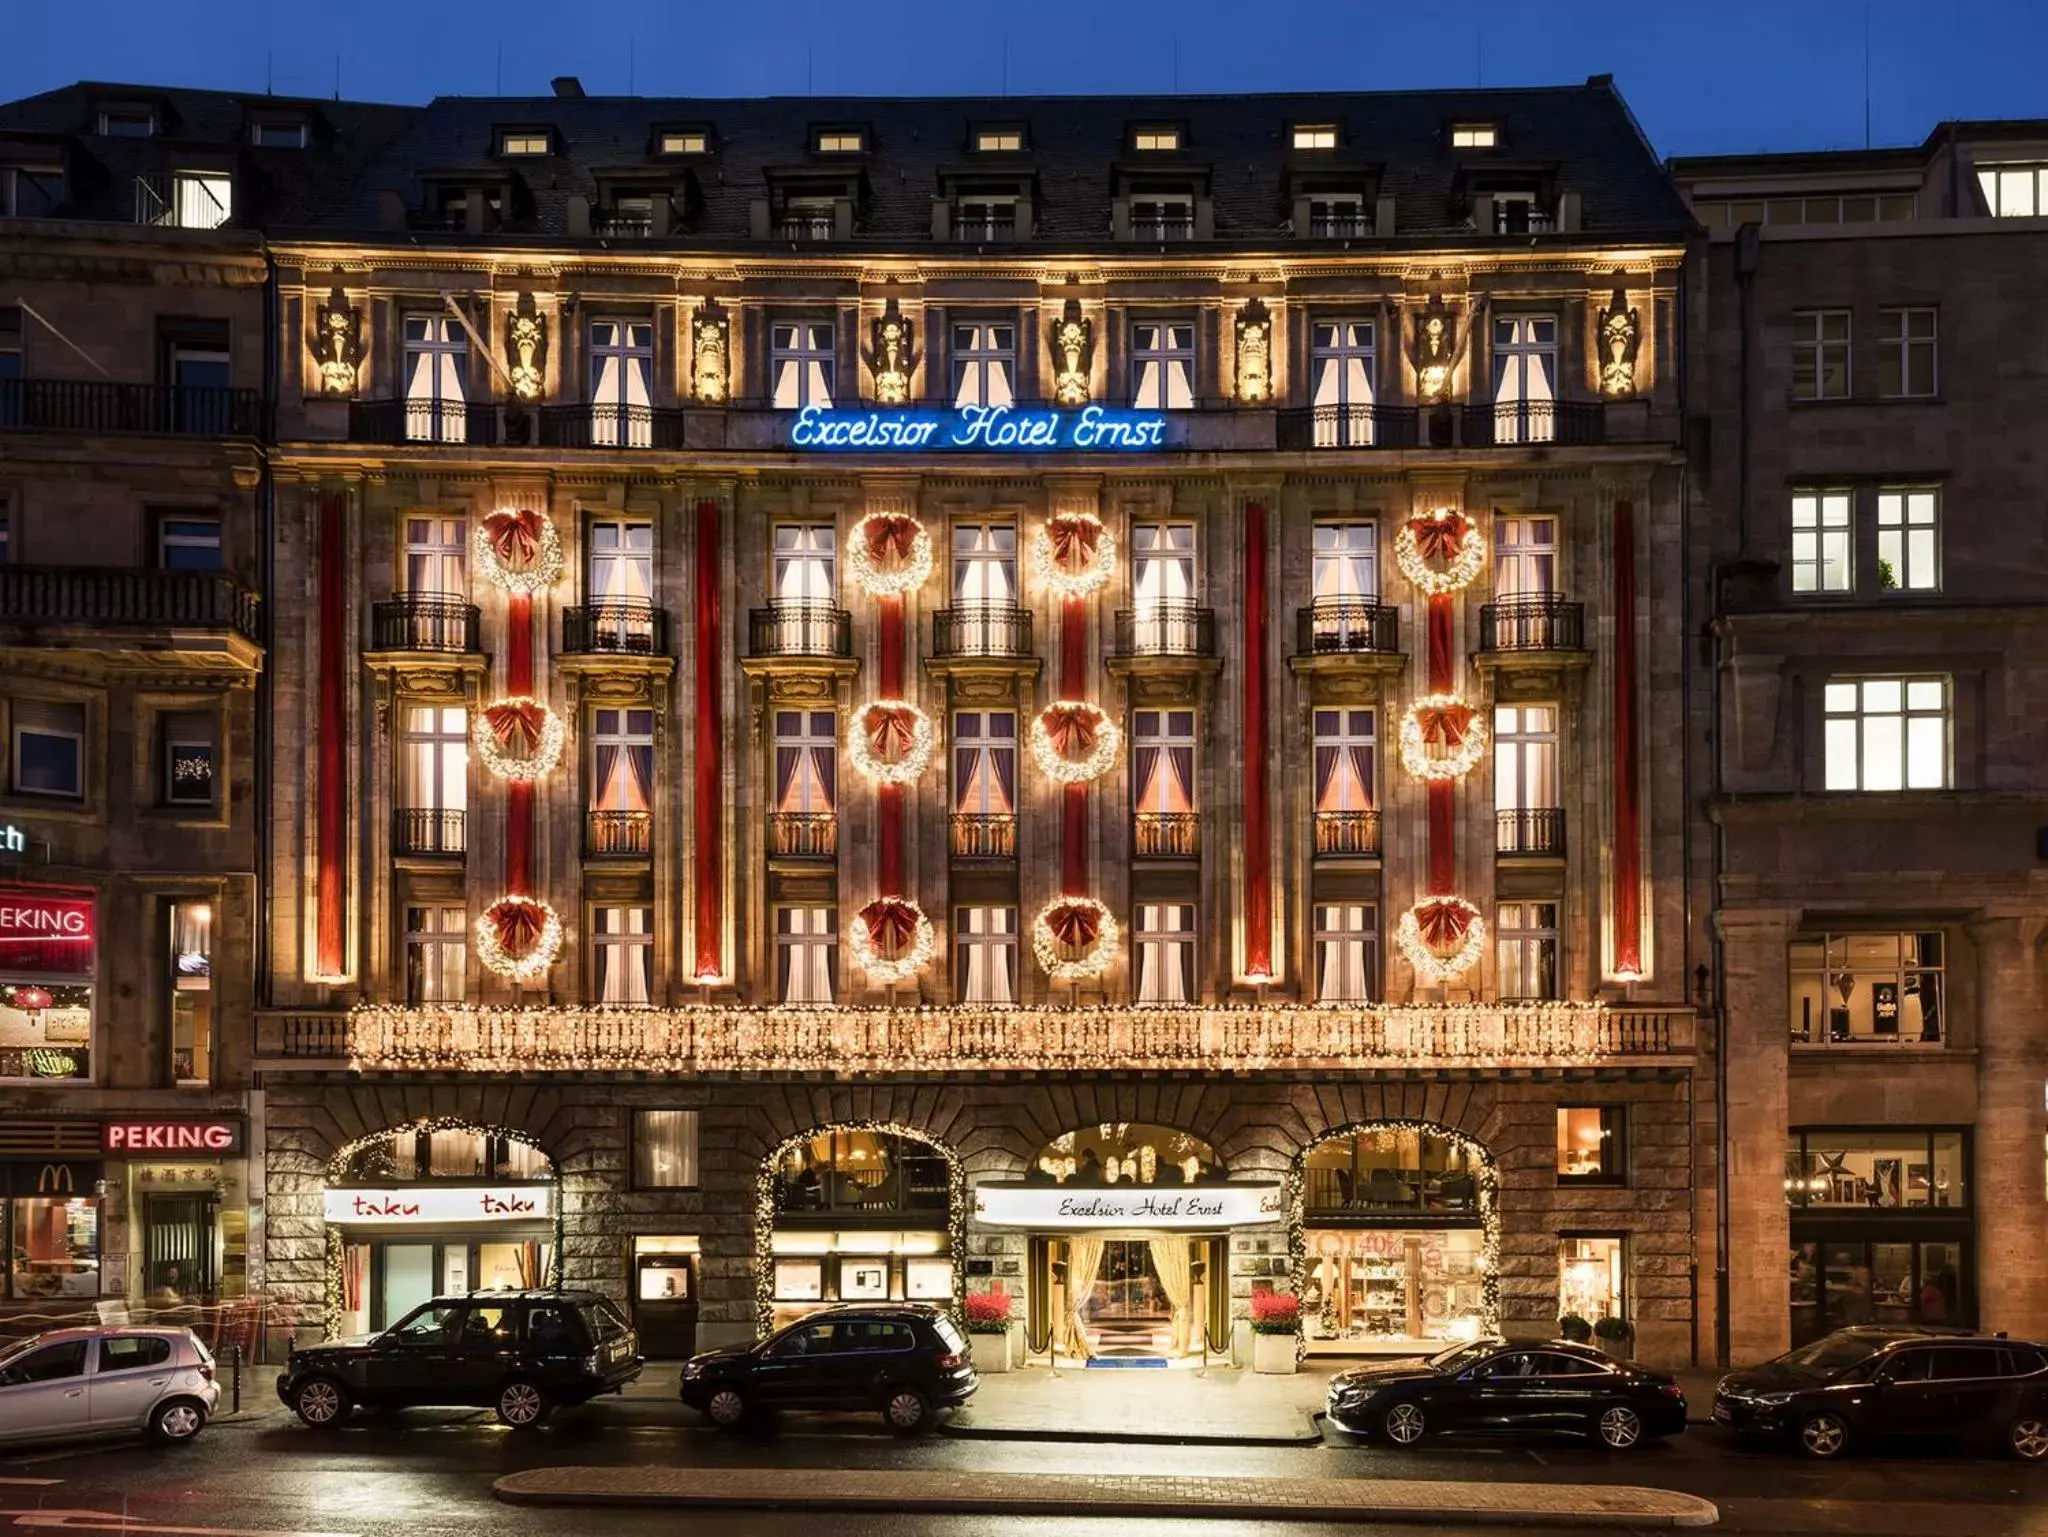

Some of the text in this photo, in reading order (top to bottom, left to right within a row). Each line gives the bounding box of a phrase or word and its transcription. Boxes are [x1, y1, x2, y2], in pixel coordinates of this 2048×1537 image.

[792, 405, 1167, 446] Excelsior Hotel Ernst
[109, 1125, 233, 1149] PEKING
[353, 1196, 420, 1216] taku
[480, 1193, 535, 1213] taku
[1058, 1195, 1223, 1217] Excelsior Hotel Ernst
